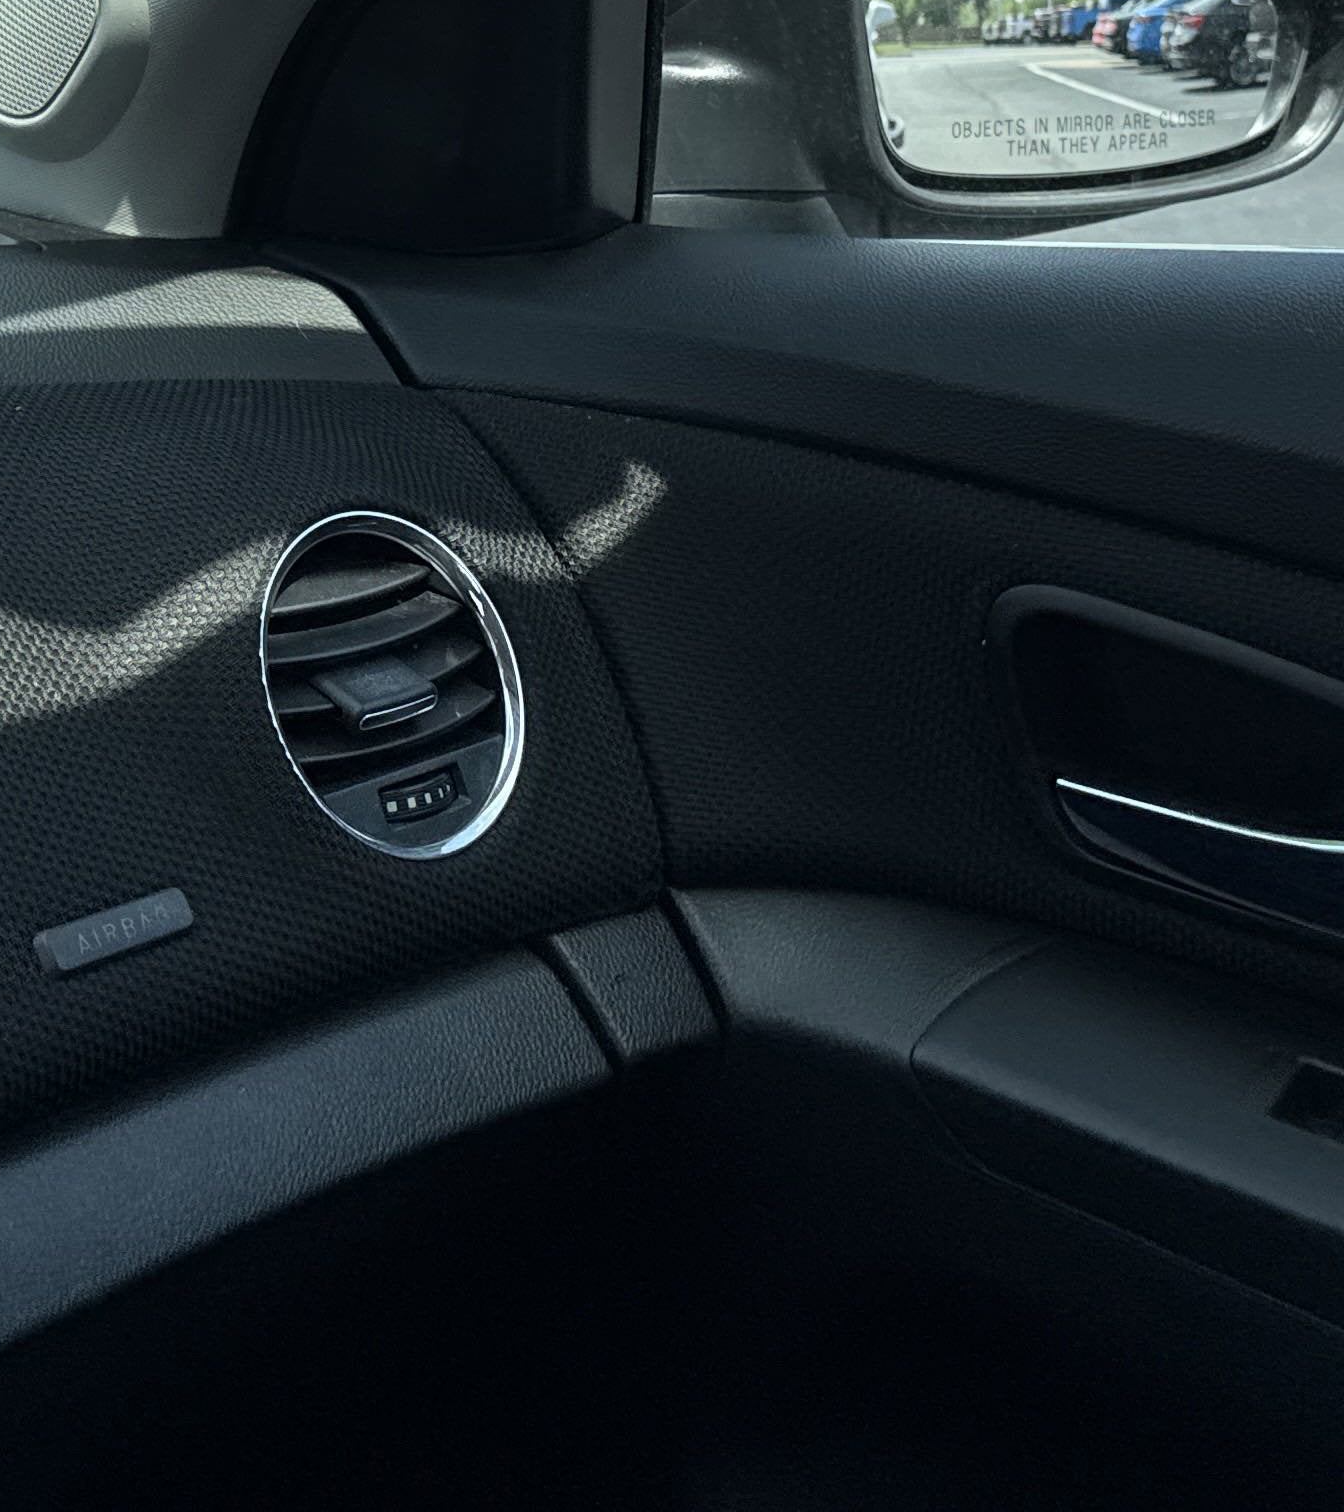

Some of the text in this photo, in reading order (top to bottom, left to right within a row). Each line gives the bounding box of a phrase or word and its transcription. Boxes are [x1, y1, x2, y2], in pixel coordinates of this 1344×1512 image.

[951, 109, 1216, 138] OBJECTS IN MIRROR ARE CLOSER
[1006, 132, 1169, 157] THAN THEY APPEAR
